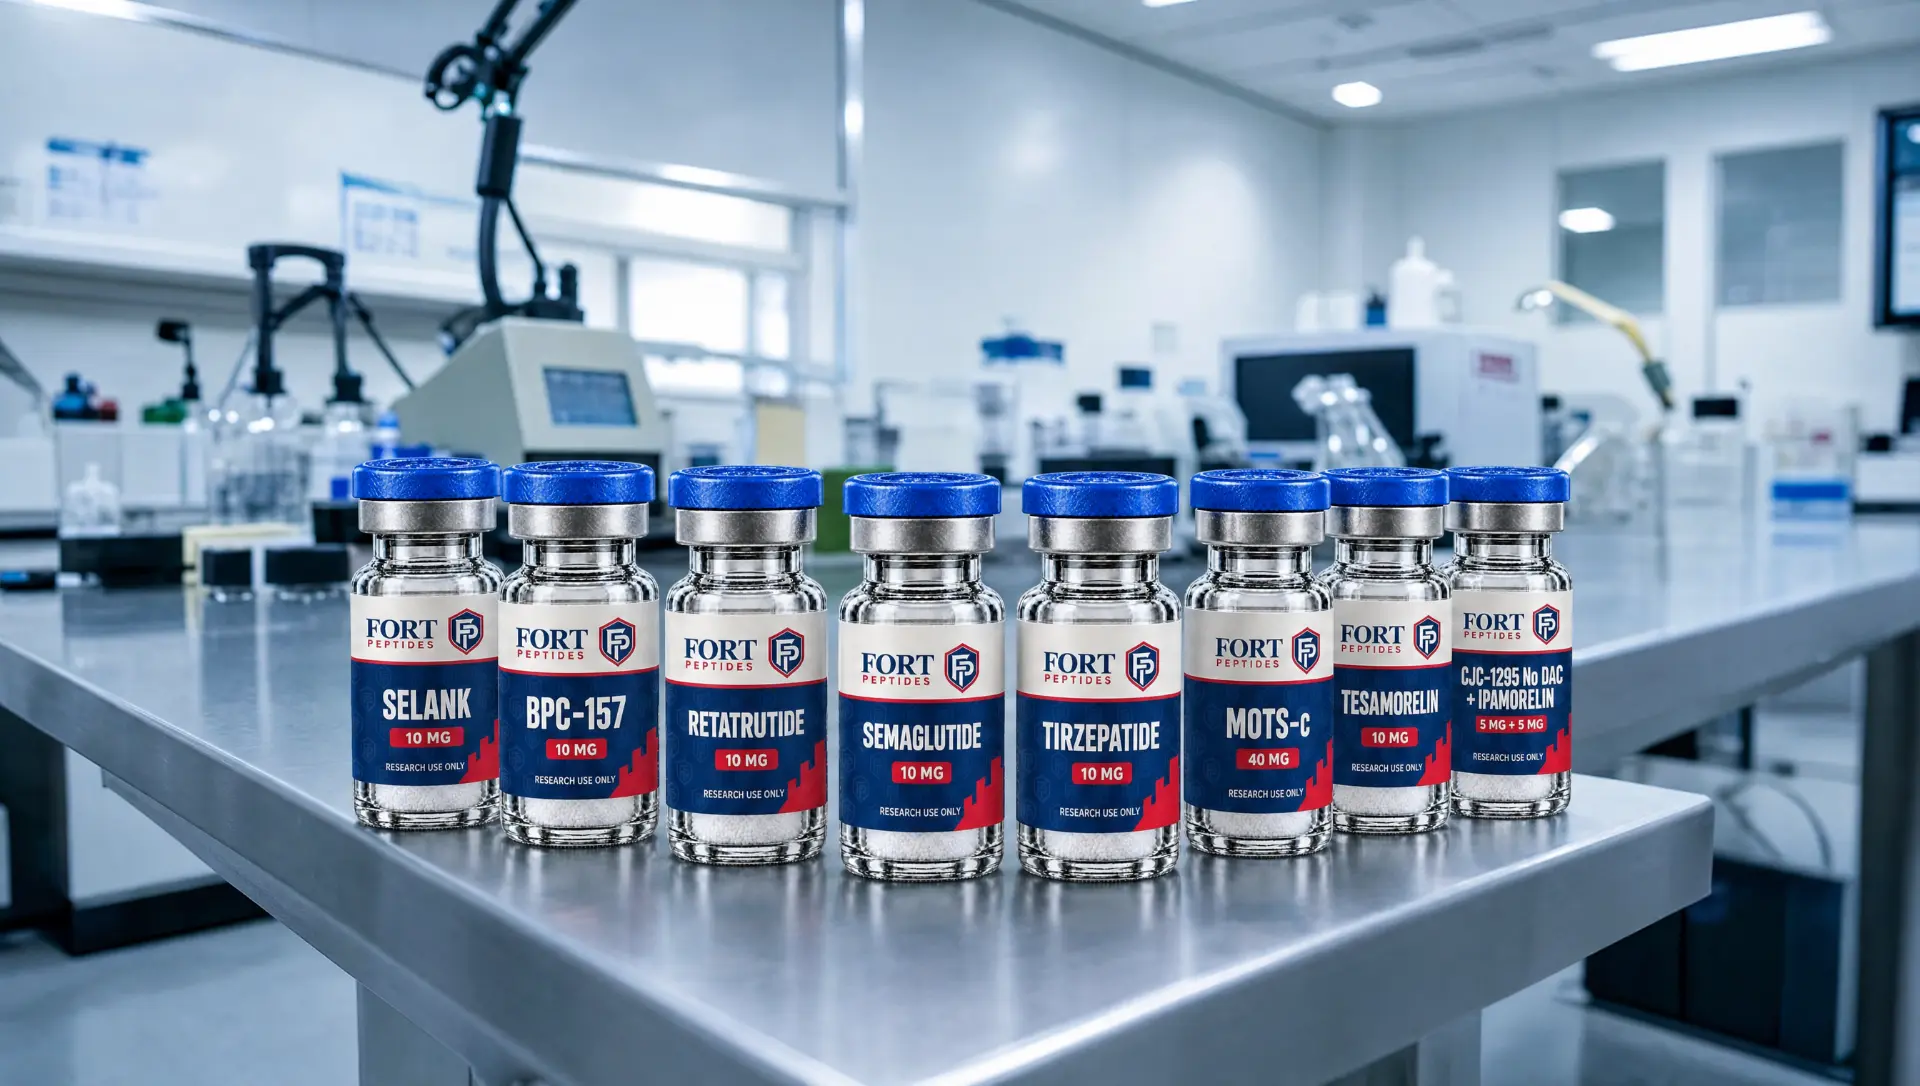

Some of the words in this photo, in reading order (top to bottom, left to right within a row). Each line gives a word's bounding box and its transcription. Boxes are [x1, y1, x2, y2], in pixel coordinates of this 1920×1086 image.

[1463, 613, 1525, 631] FORT
[366, 618, 438, 640] FORT
[1340, 624, 1405, 644] FORT
[1464, 631, 1521, 640] PEPTIDES
[367, 639, 434, 649] PEPTIDES
[516, 627, 588, 649] FORT
[684, 637, 758, 661] FORT
[1215, 637, 1283, 658] FORT
[1341, 644, 1401, 654] PEPTIDES
[517, 650, 584, 660] PEPTIDES
[685, 660, 753, 671] PEPTIDES
[861, 652, 934, 675] FORT
[1043, 651, 1116, 674] FORT
[1216, 658, 1279, 668] PEPTIDES
[862, 675, 930, 686] PEPTIDES
[1044, 673, 1112, 685] PEPTIDES
[1461, 665, 1519, 687] CJC-1295
[1522, 666, 1538, 686] No
[1541, 665, 1564, 685] DAC
[382, 687, 472, 721] SELANK
[1341, 689, 1439, 716] TESAMORELIN
[1478, 687, 1555, 710] IPAMORELIN
[526, 695, 627, 731] BPC-157
[688, 709, 805, 739] RETATRUTIDE
[1226, 707, 1311, 739] MOTS-c
[1479, 719, 1486, 730] 5
[1488, 719, 1506, 730] MG
[1518, 719, 1525, 730] 5
[1527, 719, 1544, 730] MG
[405, 732, 422, 744] 10
[426, 731, 451, 744] MG
[862, 721, 981, 751] SEMAGLUTIDE
[1042, 721, 1160, 752] TIRZEPATIDE
[1372, 731, 1385, 743] 10
[1389, 731, 1409, 744] MG
[555, 743, 573, 756] 10
[575, 743, 597, 756] MG
[725, 754, 741, 767] 10
[745, 754, 768, 767] MG
[1248, 753, 1265, 766] 40
[1268, 752, 1290, 766] MG
[1472, 752, 1509, 762] RESEARCH
[1511, 753, 1525, 762] USE
[1526, 752, 1544, 761] ONLY
[385, 762, 425, 772] RESEARCH
[427, 762, 443, 771] USE
[445, 761, 465, 771] ONLY
[900, 766, 917, 779] 10
[920, 766, 944, 780] MG
[1351, 763, 1389, 773] RESEARCH
[1390, 763, 1404, 772] USE
[1405, 763, 1423, 772] ONLY
[534, 775, 575, 785] RESEARCH
[577, 775, 593, 785] USE
[594, 774, 616, 784] ONLY
[1081, 767, 1097, 780] 10
[1101, 767, 1124, 781] MG
[703, 789, 744, 799] RESEARCH
[746, 790, 762, 799] USE
[763, 789, 785, 799] ONLY
[1228, 788, 1269, 799] RESEARCH
[1270, 789, 1284, 799] USE
[1285, 788, 1304, 798] ONLY
[879, 807, 921, 817] RESEARCH
[923, 807, 939, 817] USE
[940, 807, 961, 817] ONLY
[1059, 807, 1101, 818] RESEARCH
[1102, 807, 1118, 817] USE
[1120, 807, 1140, 817] ONLY
